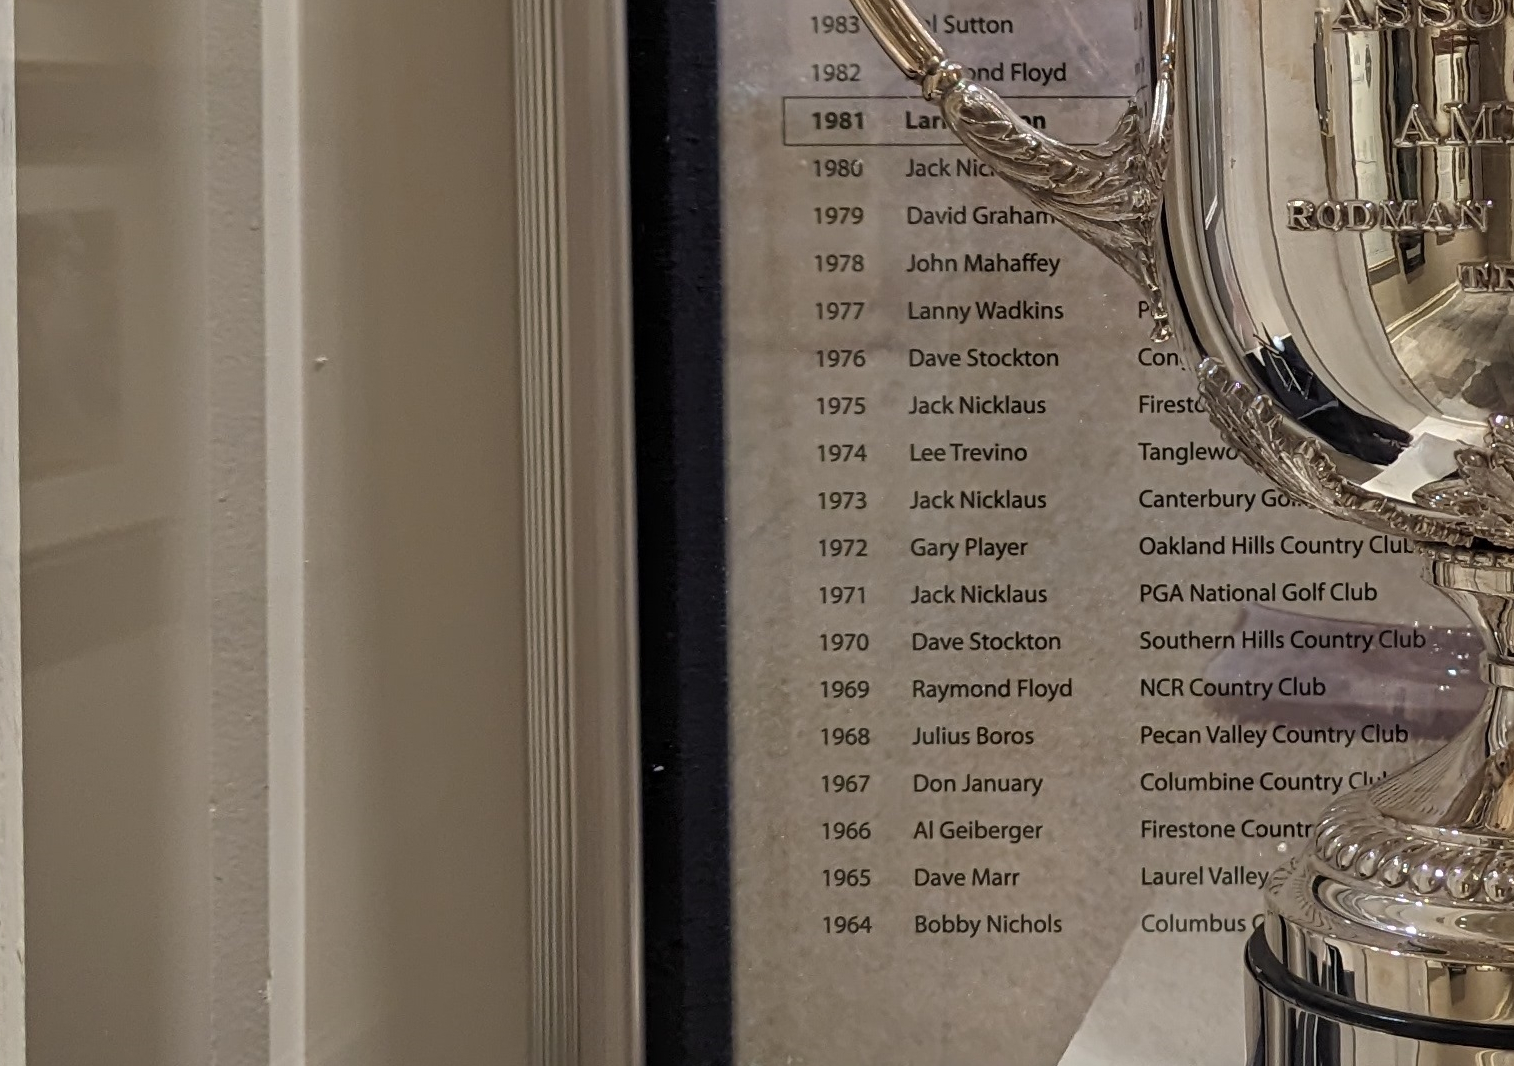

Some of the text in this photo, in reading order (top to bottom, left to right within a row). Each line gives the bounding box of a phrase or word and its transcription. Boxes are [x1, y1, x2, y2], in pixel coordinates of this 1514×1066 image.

[1287, 200, 1494, 232] RODMAN
[814, 252, 1061, 278] 1978 John Mahaffey
[815, 299, 1065, 325] 1977 Lanny Wadkins
[819, 581, 1378, 605] 1971 Jack Nicklaus PGA National Golf Club
[819, 629, 1427, 654] 1970 Dave Stockton Southern Hills Country Club
[820, 676, 1327, 704] 1969 Raymond Floyd NCR Country Club
[820, 723, 1409, 749] 1968 Julius Boros Pecan Valley Country Club
